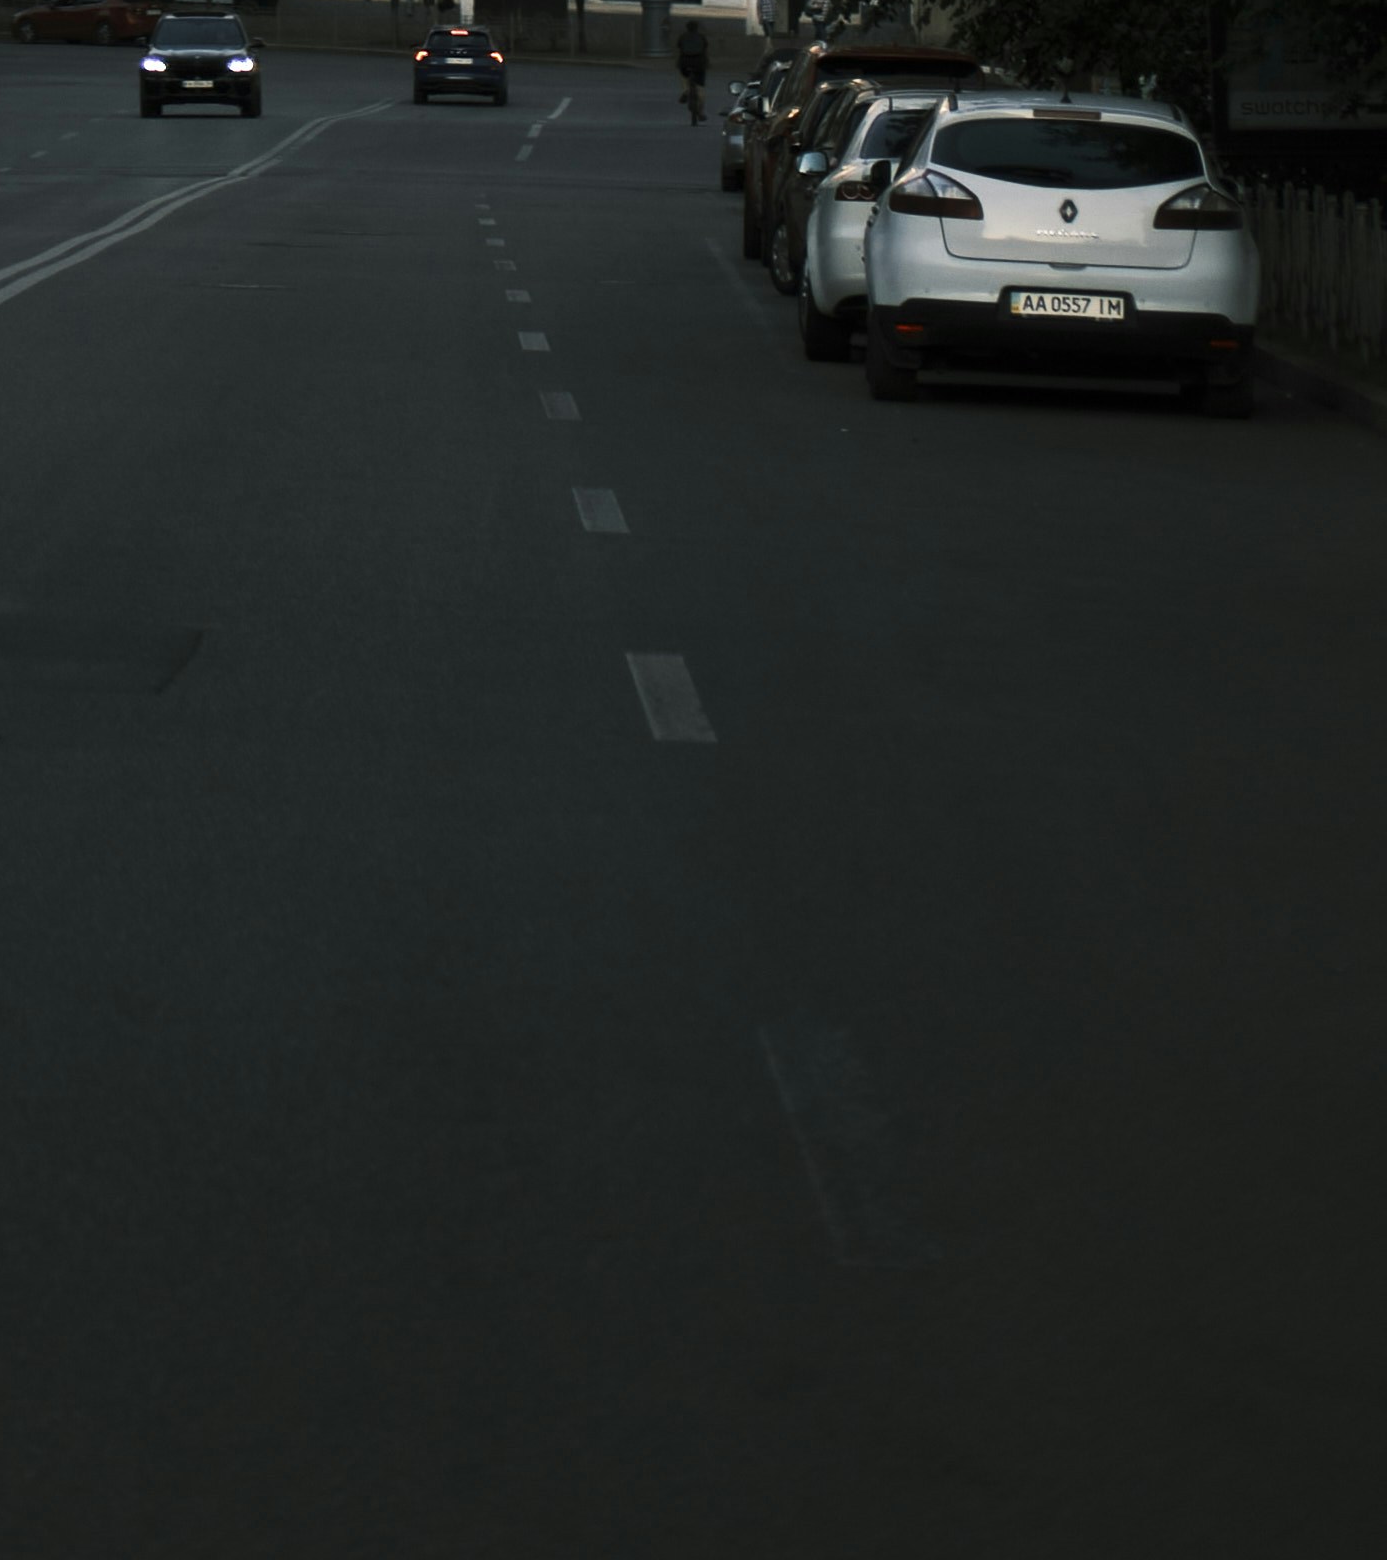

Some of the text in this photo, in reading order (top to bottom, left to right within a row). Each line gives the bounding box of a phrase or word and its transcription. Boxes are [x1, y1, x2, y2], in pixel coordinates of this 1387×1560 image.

[1022, 294, 1121, 316] AA 0557 IM
